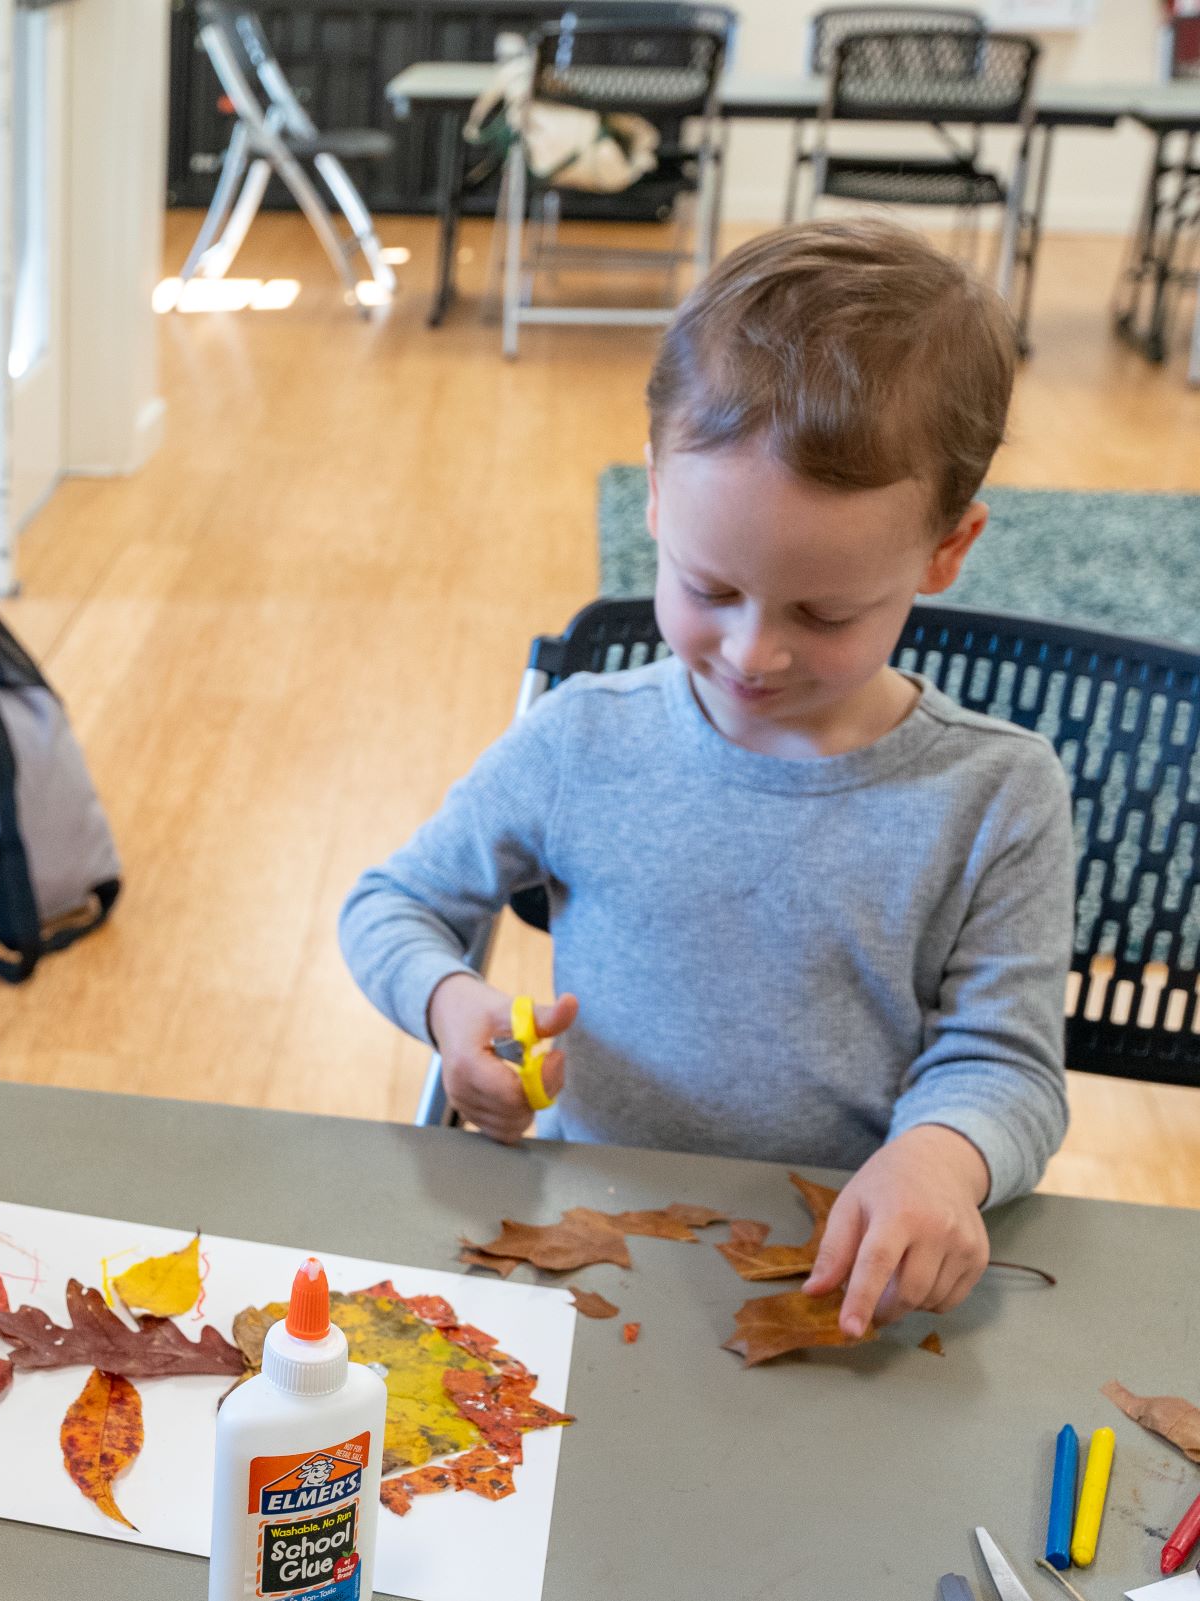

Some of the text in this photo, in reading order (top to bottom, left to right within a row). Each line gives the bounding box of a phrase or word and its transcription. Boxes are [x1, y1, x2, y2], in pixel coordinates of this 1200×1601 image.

[267, 1472, 359, 1511] ELMER'S
[322, 1518, 334, 1529] No
[336, 1511, 352, 1524] Run
[270, 1522, 351, 1562] School
[279, 1557, 334, 1582] Glue
